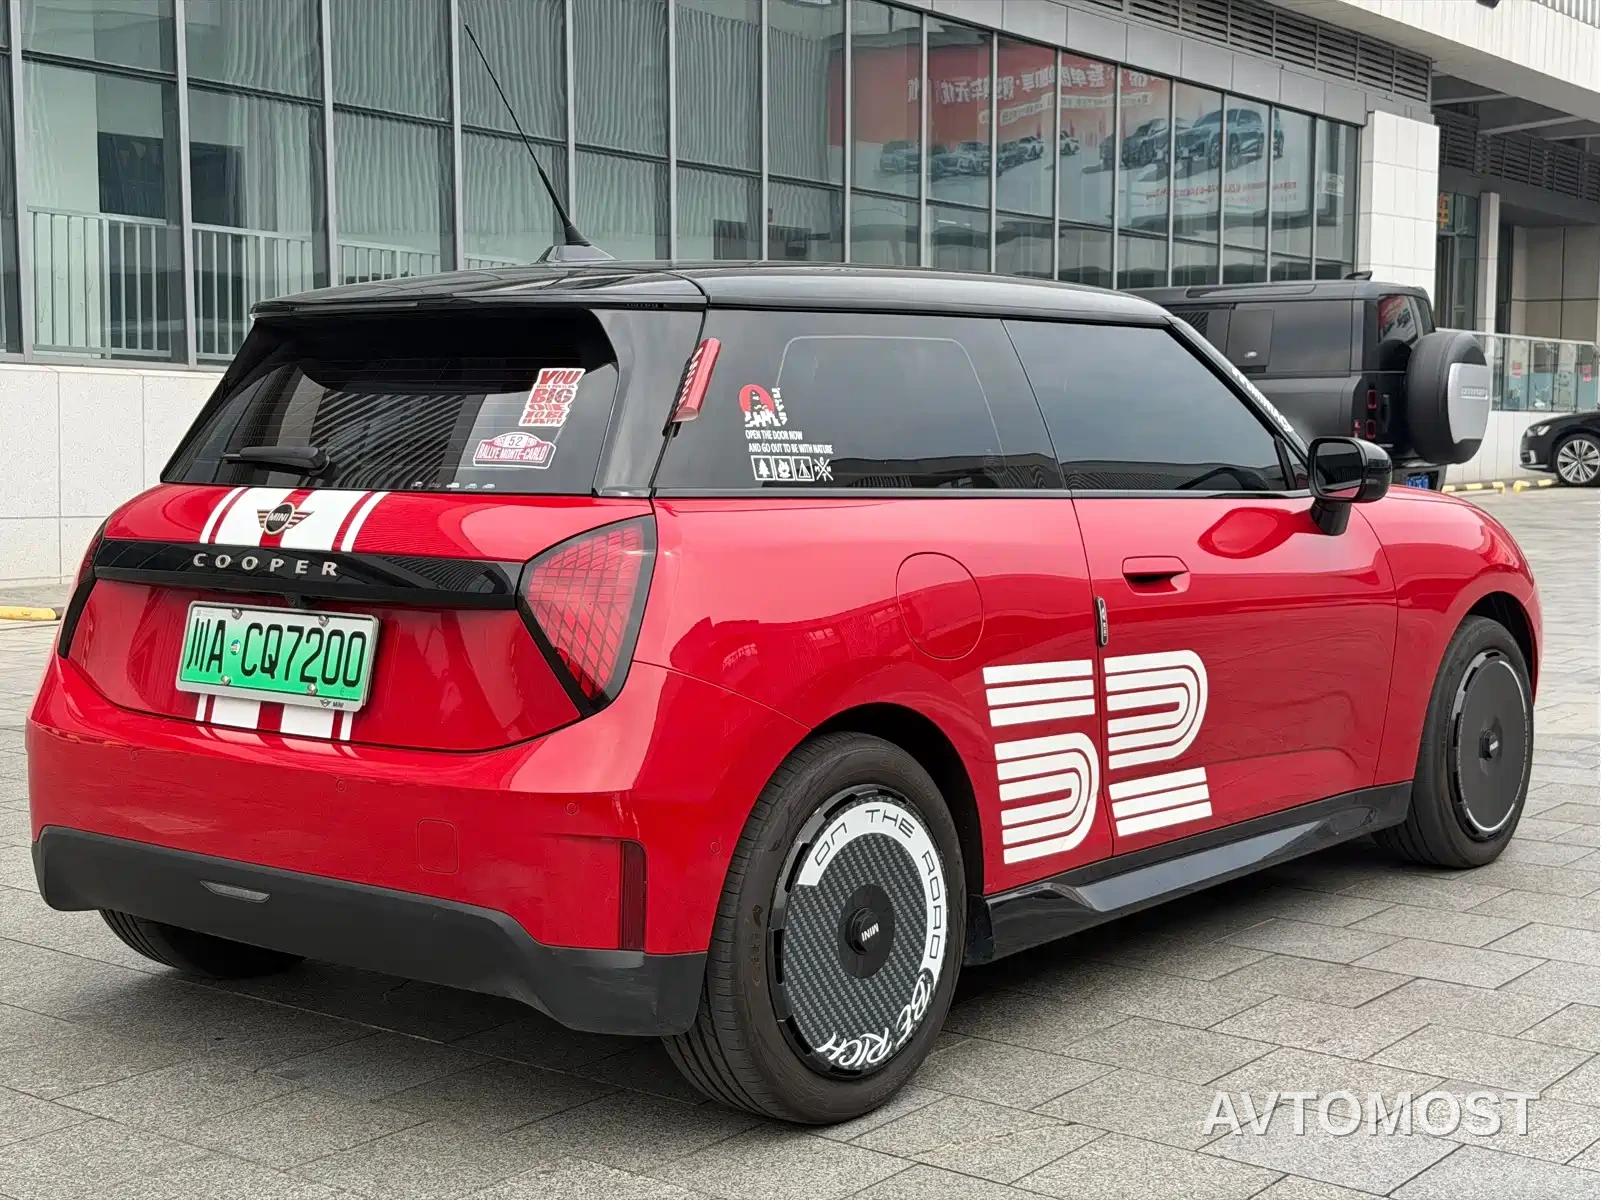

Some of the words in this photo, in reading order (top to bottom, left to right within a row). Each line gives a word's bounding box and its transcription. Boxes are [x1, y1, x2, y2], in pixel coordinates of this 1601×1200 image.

[539, 370, 583, 384] YOU
[531, 388, 573, 404] BIG
[508, 436, 524, 447] 52
[745, 430, 761, 440] OPEN
[761, 430, 772, 440] THE
[772, 431, 789, 440] DOOR
[788, 431, 803, 441] NOW
[477, 443, 501, 459] RALLYE
[499, 445, 548, 460] MONTE-CARLO
[748, 443, 761, 453] AND
[761, 443, 770, 453] GO
[770, 443, 783, 453] OUT
[782, 444, 791, 453] TO
[791, 444, 799, 453] BE
[798, 444, 813, 453] WITH
[812, 444, 834, 454] NATURE
[267, 512, 289, 523] MINI
[193, 553, 338, 577] COOPER
[983, 650, 1213, 865] 52
[814, 822, 848, 867] ON
[865, 808, 916, 840] THE
[921, 852, 944, 960] ROAD
[861, 922, 879, 942] MINI
[815, 1027, 893, 1067] RICH
